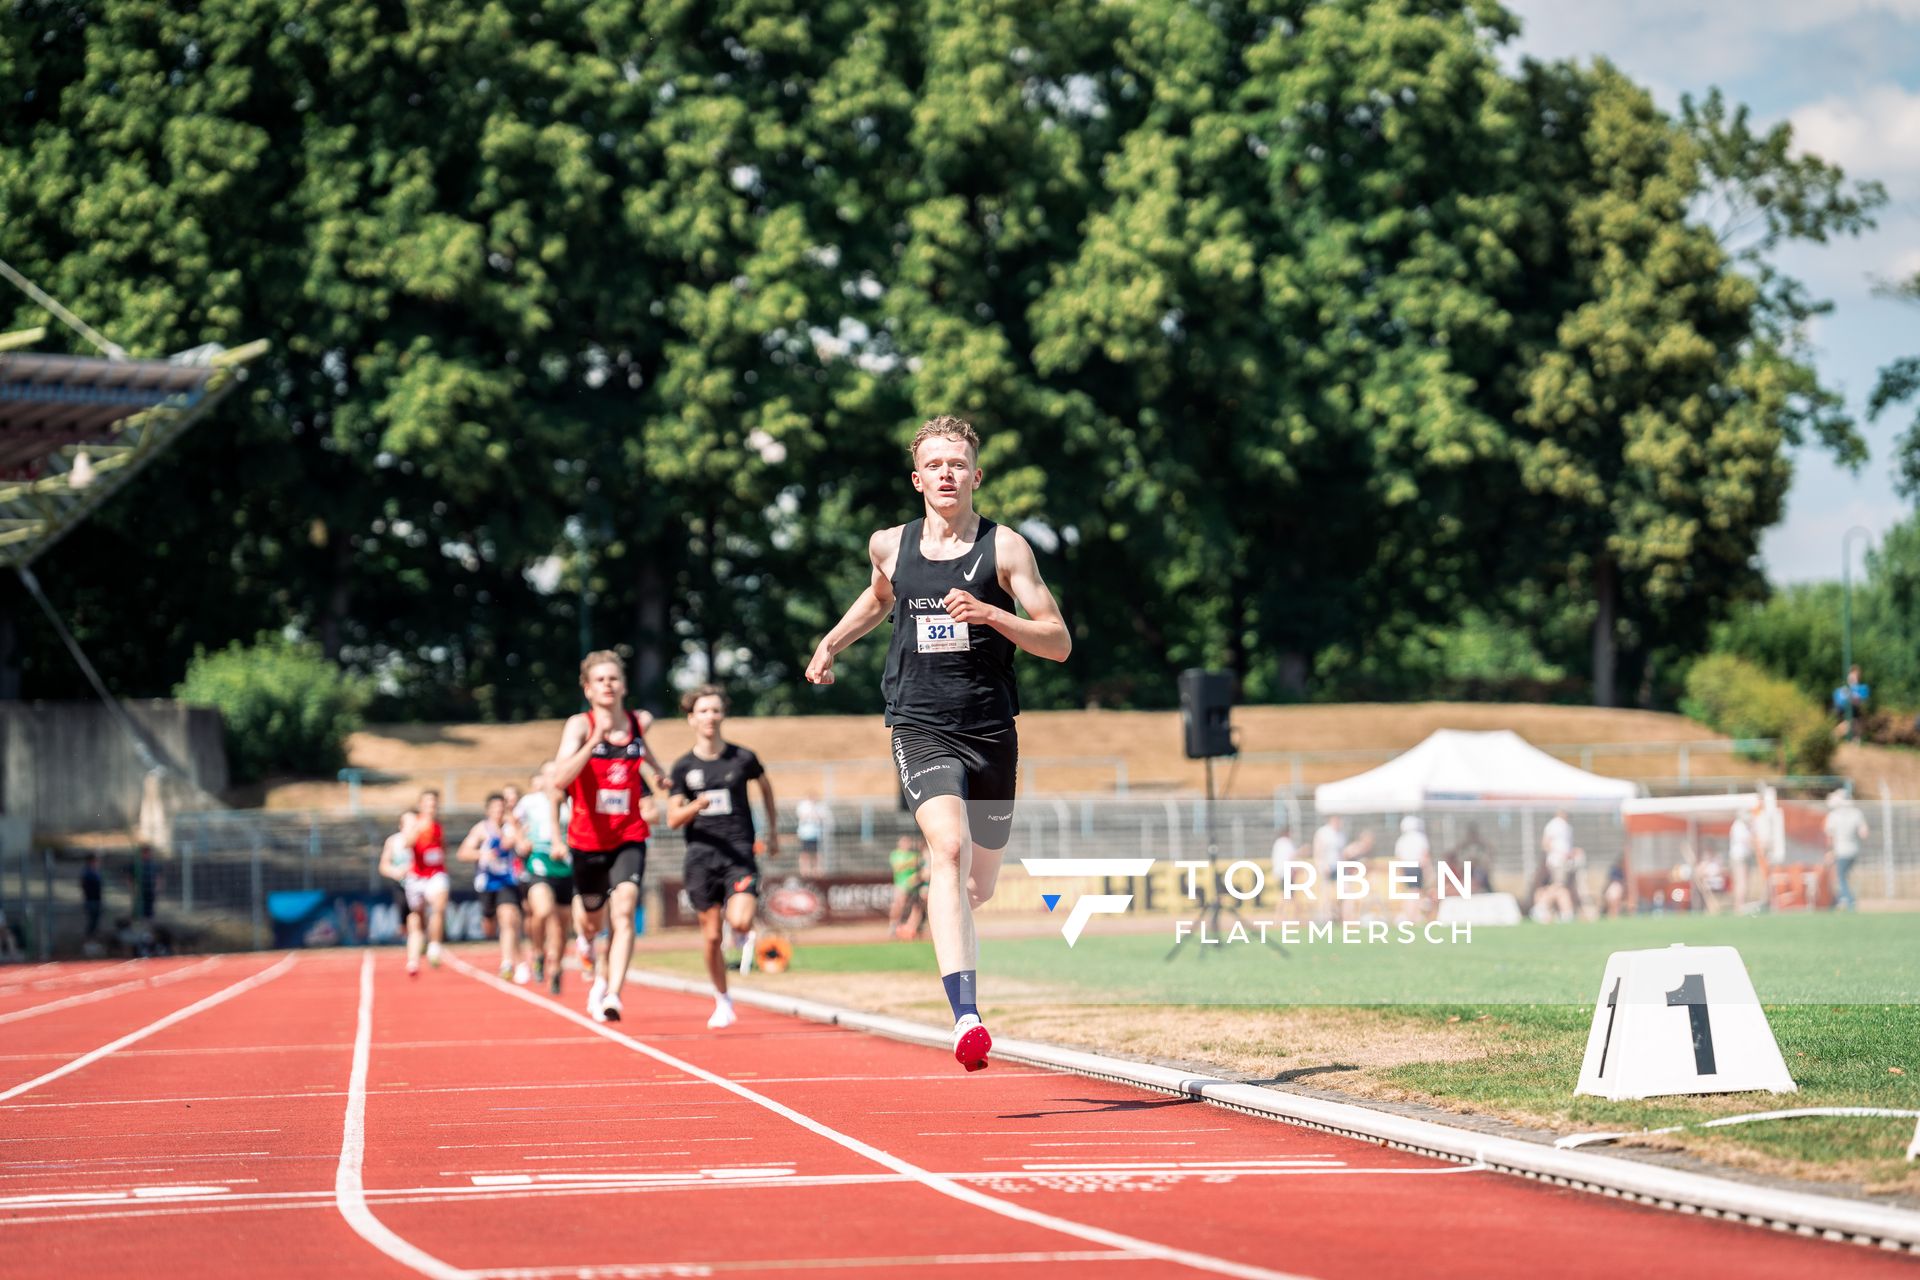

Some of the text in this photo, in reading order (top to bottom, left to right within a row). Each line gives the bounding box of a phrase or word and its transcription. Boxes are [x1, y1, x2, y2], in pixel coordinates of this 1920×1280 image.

[928, 624, 955, 639] 321
[1598, 977, 1621, 1078] 1
[1665, 973, 1717, 1075] 1
